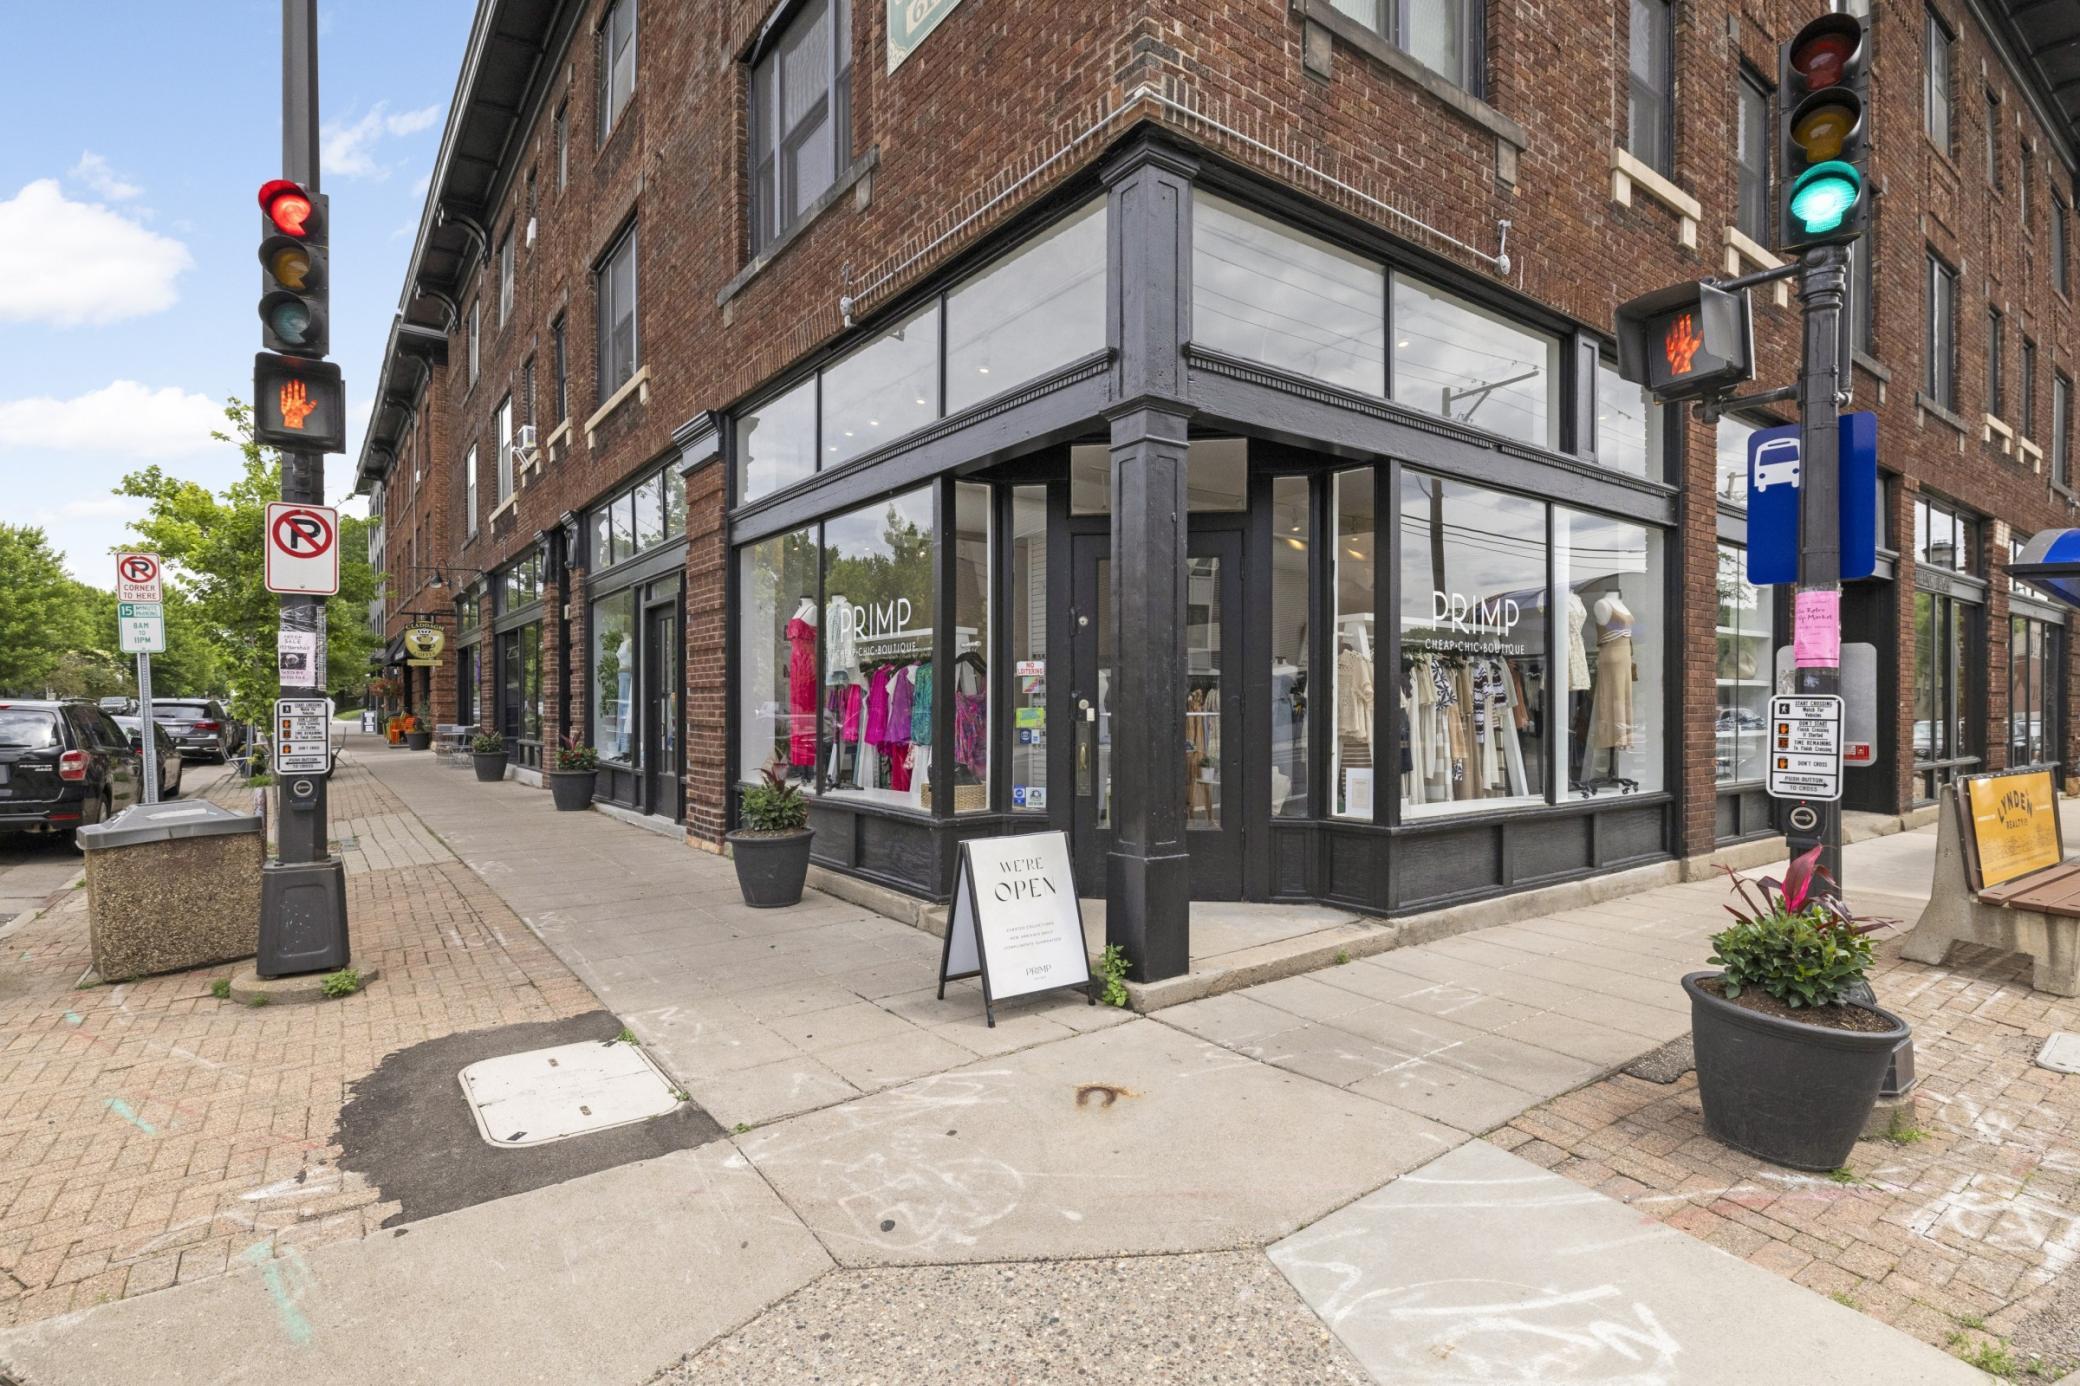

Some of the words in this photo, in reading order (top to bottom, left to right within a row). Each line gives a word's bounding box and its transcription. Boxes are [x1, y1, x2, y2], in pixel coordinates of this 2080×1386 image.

[121, 605, 133, 616] 15
[840, 598, 911, 643] PRIMP
[1432, 590, 1519, 637] PRIMP
[405, 623, 445, 631] CLADDAGH
[1997, 790, 2032, 824] LYNDEN
[999, 857, 1044, 873] WE'RE
[994, 876, 1056, 902] OPEN
[1025, 964, 1052, 976] PRIMP
